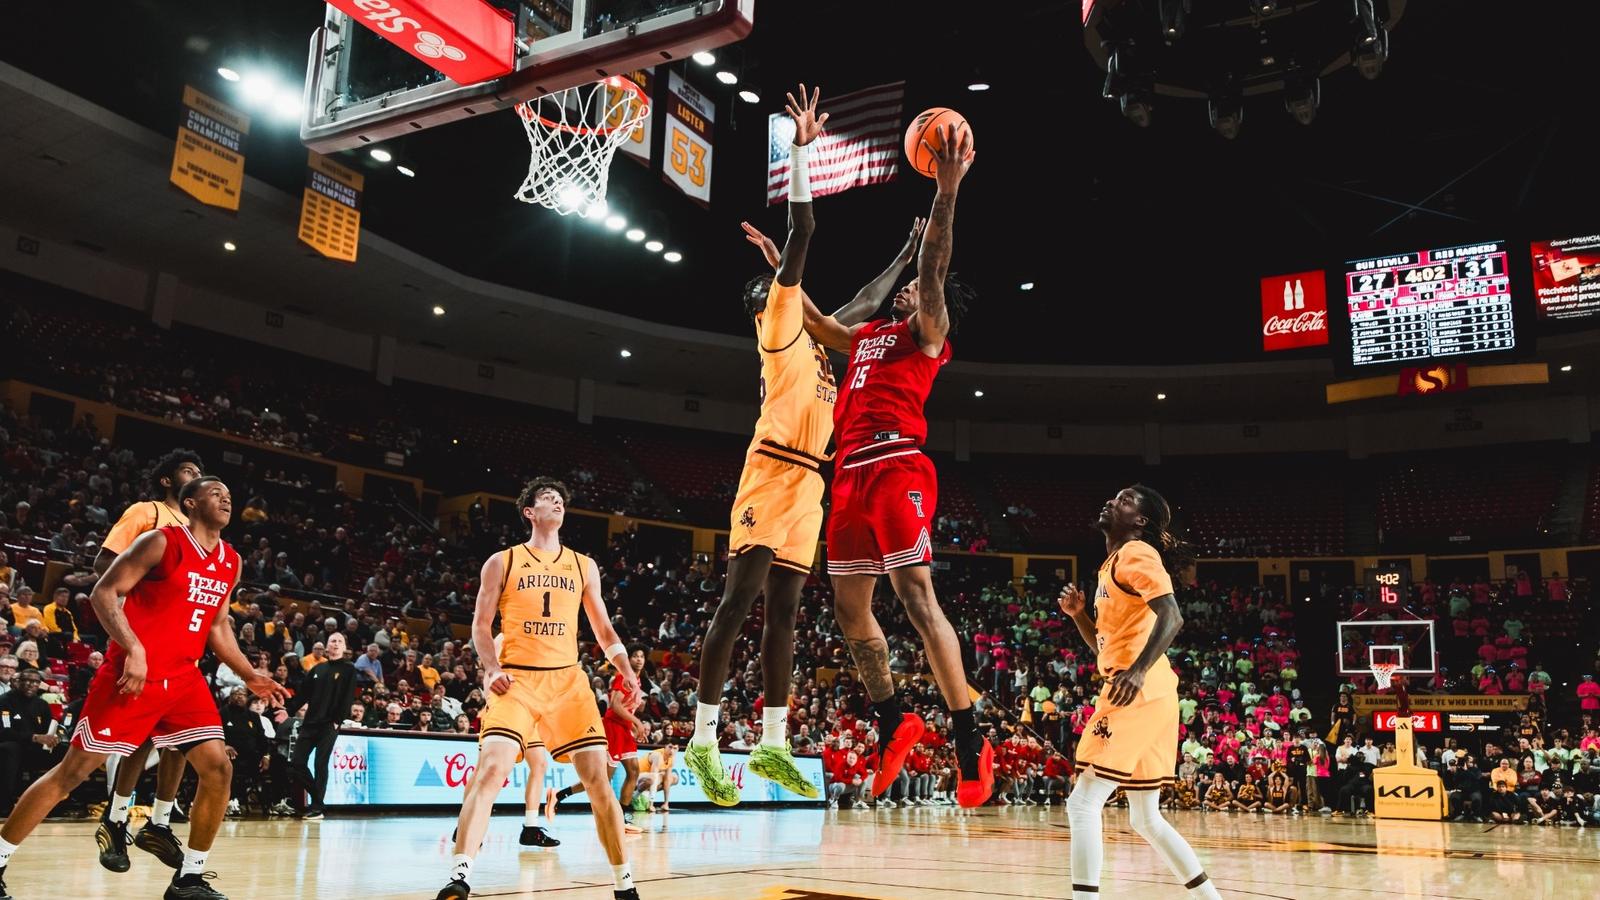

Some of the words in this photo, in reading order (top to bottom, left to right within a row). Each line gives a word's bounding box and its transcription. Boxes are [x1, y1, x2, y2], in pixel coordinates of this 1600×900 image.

[188, 110, 240, 142] CONFERENCE
[678, 103, 704, 133] LISTER
[187, 120, 240, 152] CHAMPIONS
[670, 126, 707, 187] 53
[312, 171, 356, 199] CONFERENCE
[312, 180, 356, 208] CHAMPIONS
[1435, 250, 1454, 260] RED
[1456, 244, 1497, 256] RAIDERS
[1356, 261, 1375, 270] SUN
[1377, 256, 1410, 268] DEVILS
[1465, 258, 1494, 278] 31
[1359, 274, 1386, 292] 27
[1405, 266, 1446, 282] 4:02
[1538, 285, 1578, 296] Pitchfork
[1540, 295, 1559, 304] loud
[1561, 294, 1578, 302] and
[1263, 310, 1327, 336] Coca-Cola
[857, 334, 898, 350] TEXAS
[853, 348, 886, 364] TECH
[850, 364, 870, 390] 15
[816, 384, 836, 404] STA
[188, 572, 228, 594] TEXAS
[517, 575, 575, 592] ARIZONA
[1376, 574, 1399, 584] 4:02
[187, 586, 221, 607] TECH
[542, 592, 550, 617] 1
[1381, 586, 1397, 603] 16
[188, 608, 206, 632] 5
[524, 621, 566, 636] STATE
[514, 767, 564, 788] LIHT
